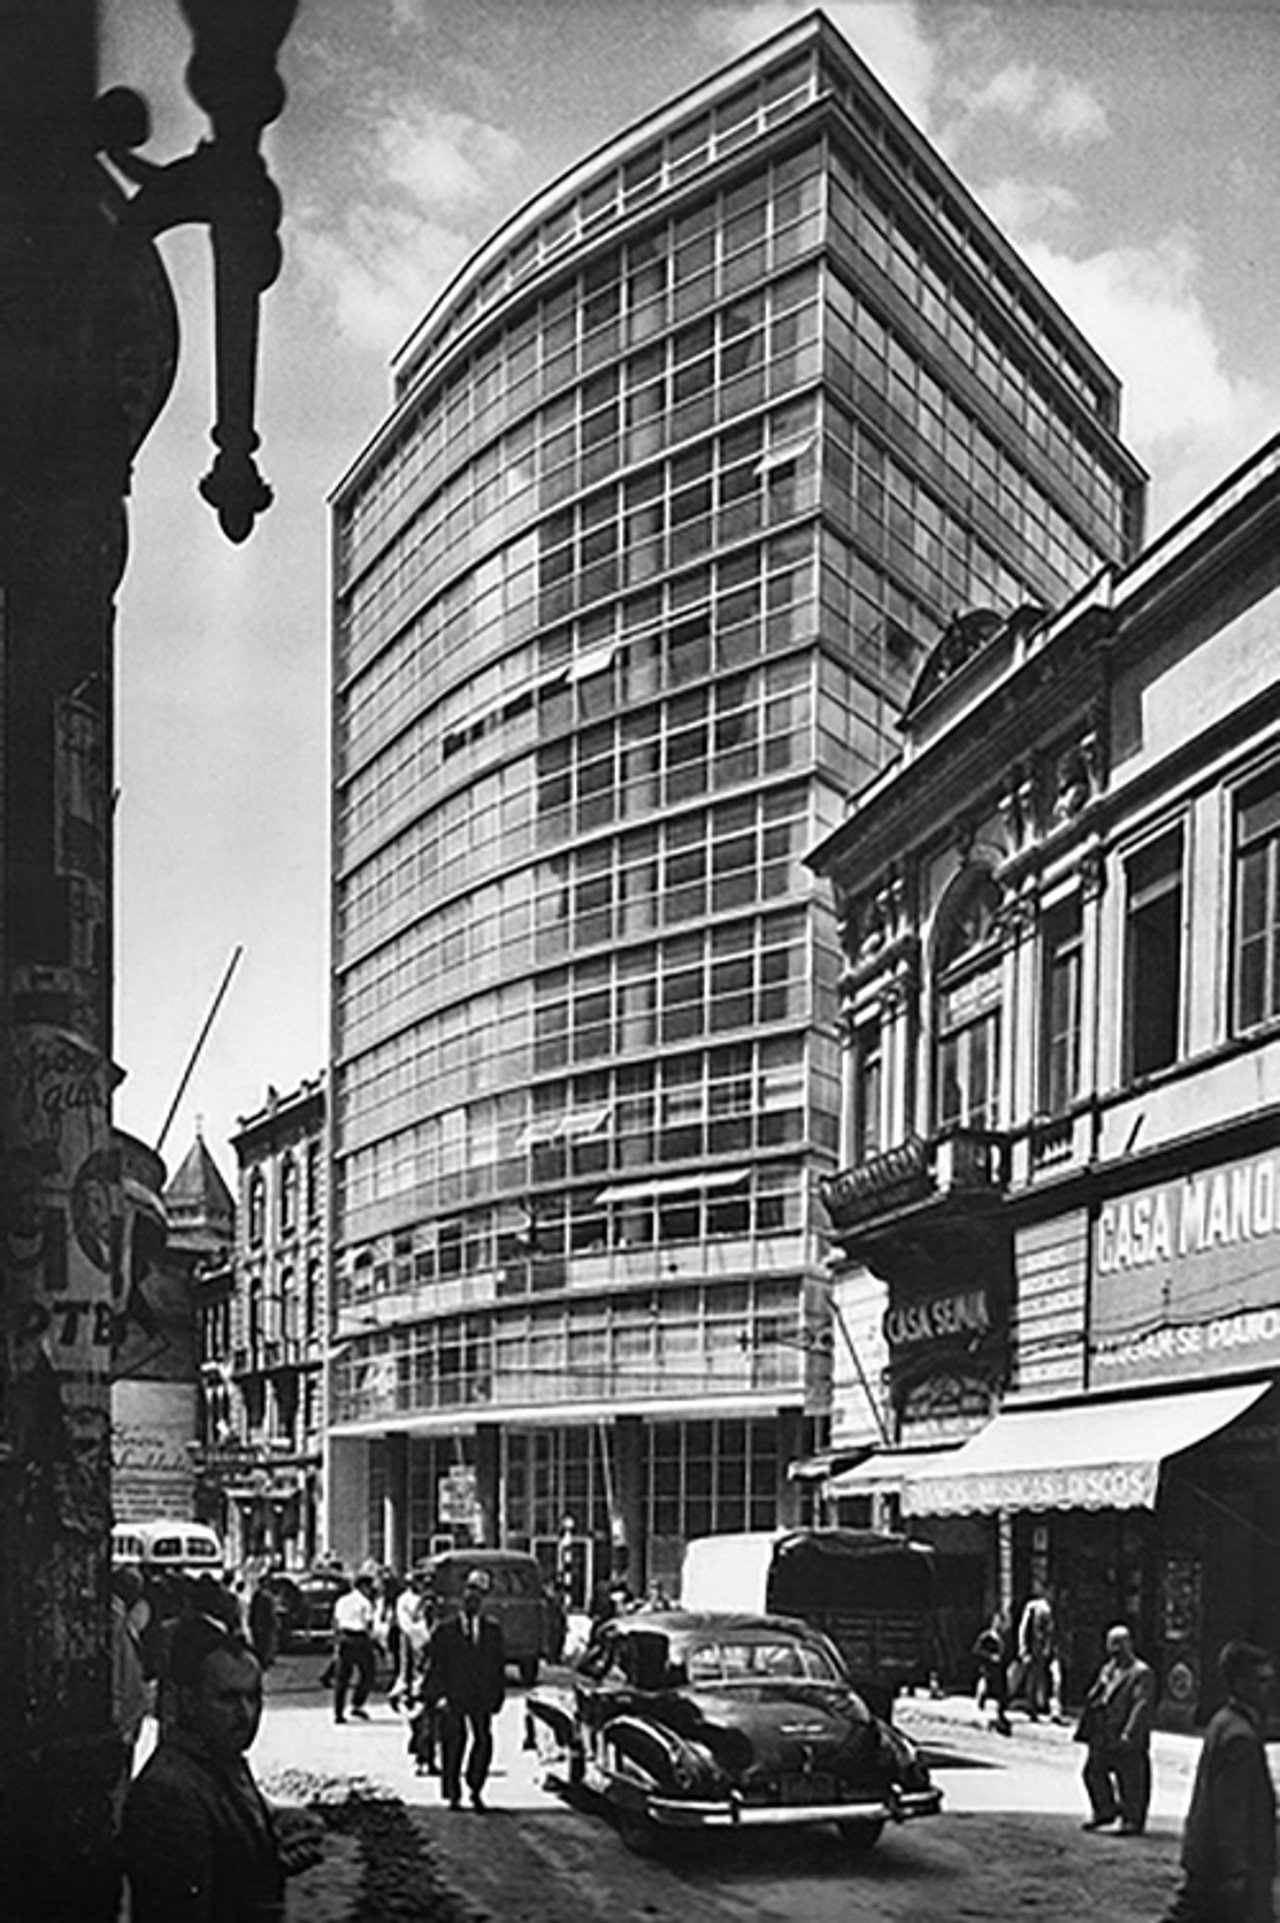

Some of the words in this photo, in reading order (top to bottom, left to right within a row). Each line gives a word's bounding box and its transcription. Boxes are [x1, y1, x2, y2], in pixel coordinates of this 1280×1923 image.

[1097, 1191, 1171, 1272] CASA
[1179, 1159, 1280, 1254] MANO
[886, 1305, 934, 1343] CASA
